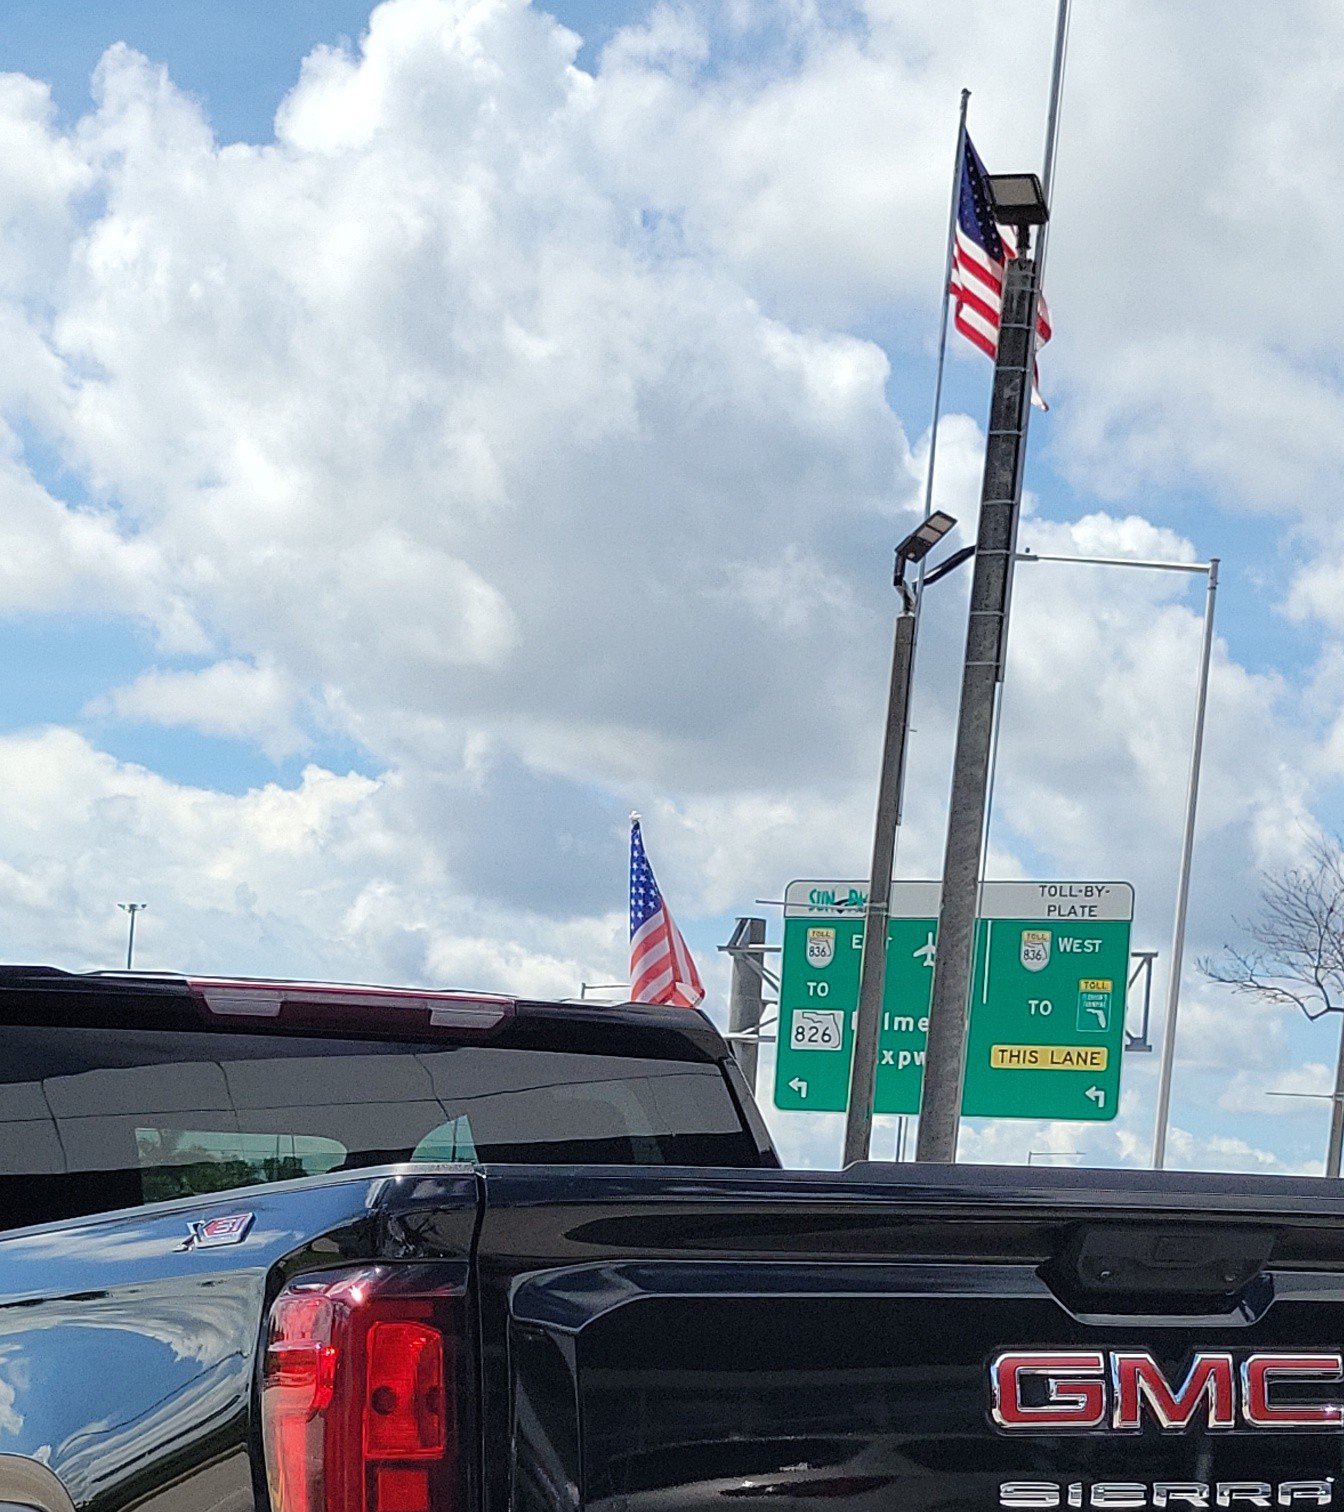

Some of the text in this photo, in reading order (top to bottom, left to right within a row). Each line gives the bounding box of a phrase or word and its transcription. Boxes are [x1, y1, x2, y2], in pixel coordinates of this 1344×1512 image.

[1046, 904, 1098, 918] PLATE
[811, 930, 831, 938] TOLL
[1026, 932, 1047, 941] TOLL
[808, 945, 827, 958] 836
[1058, 937, 1103, 953] WEST
[1023, 949, 1042, 961] 836
[806, 981, 829, 997] TO
[1083, 981, 1108, 990] TOLL
[1028, 999, 1053, 1016] TO
[794, 1025, 832, 1043] 826
[998, 1049, 1101, 1066] THIS LANE
[998, 1477, 1335, 1508] SIERRA
